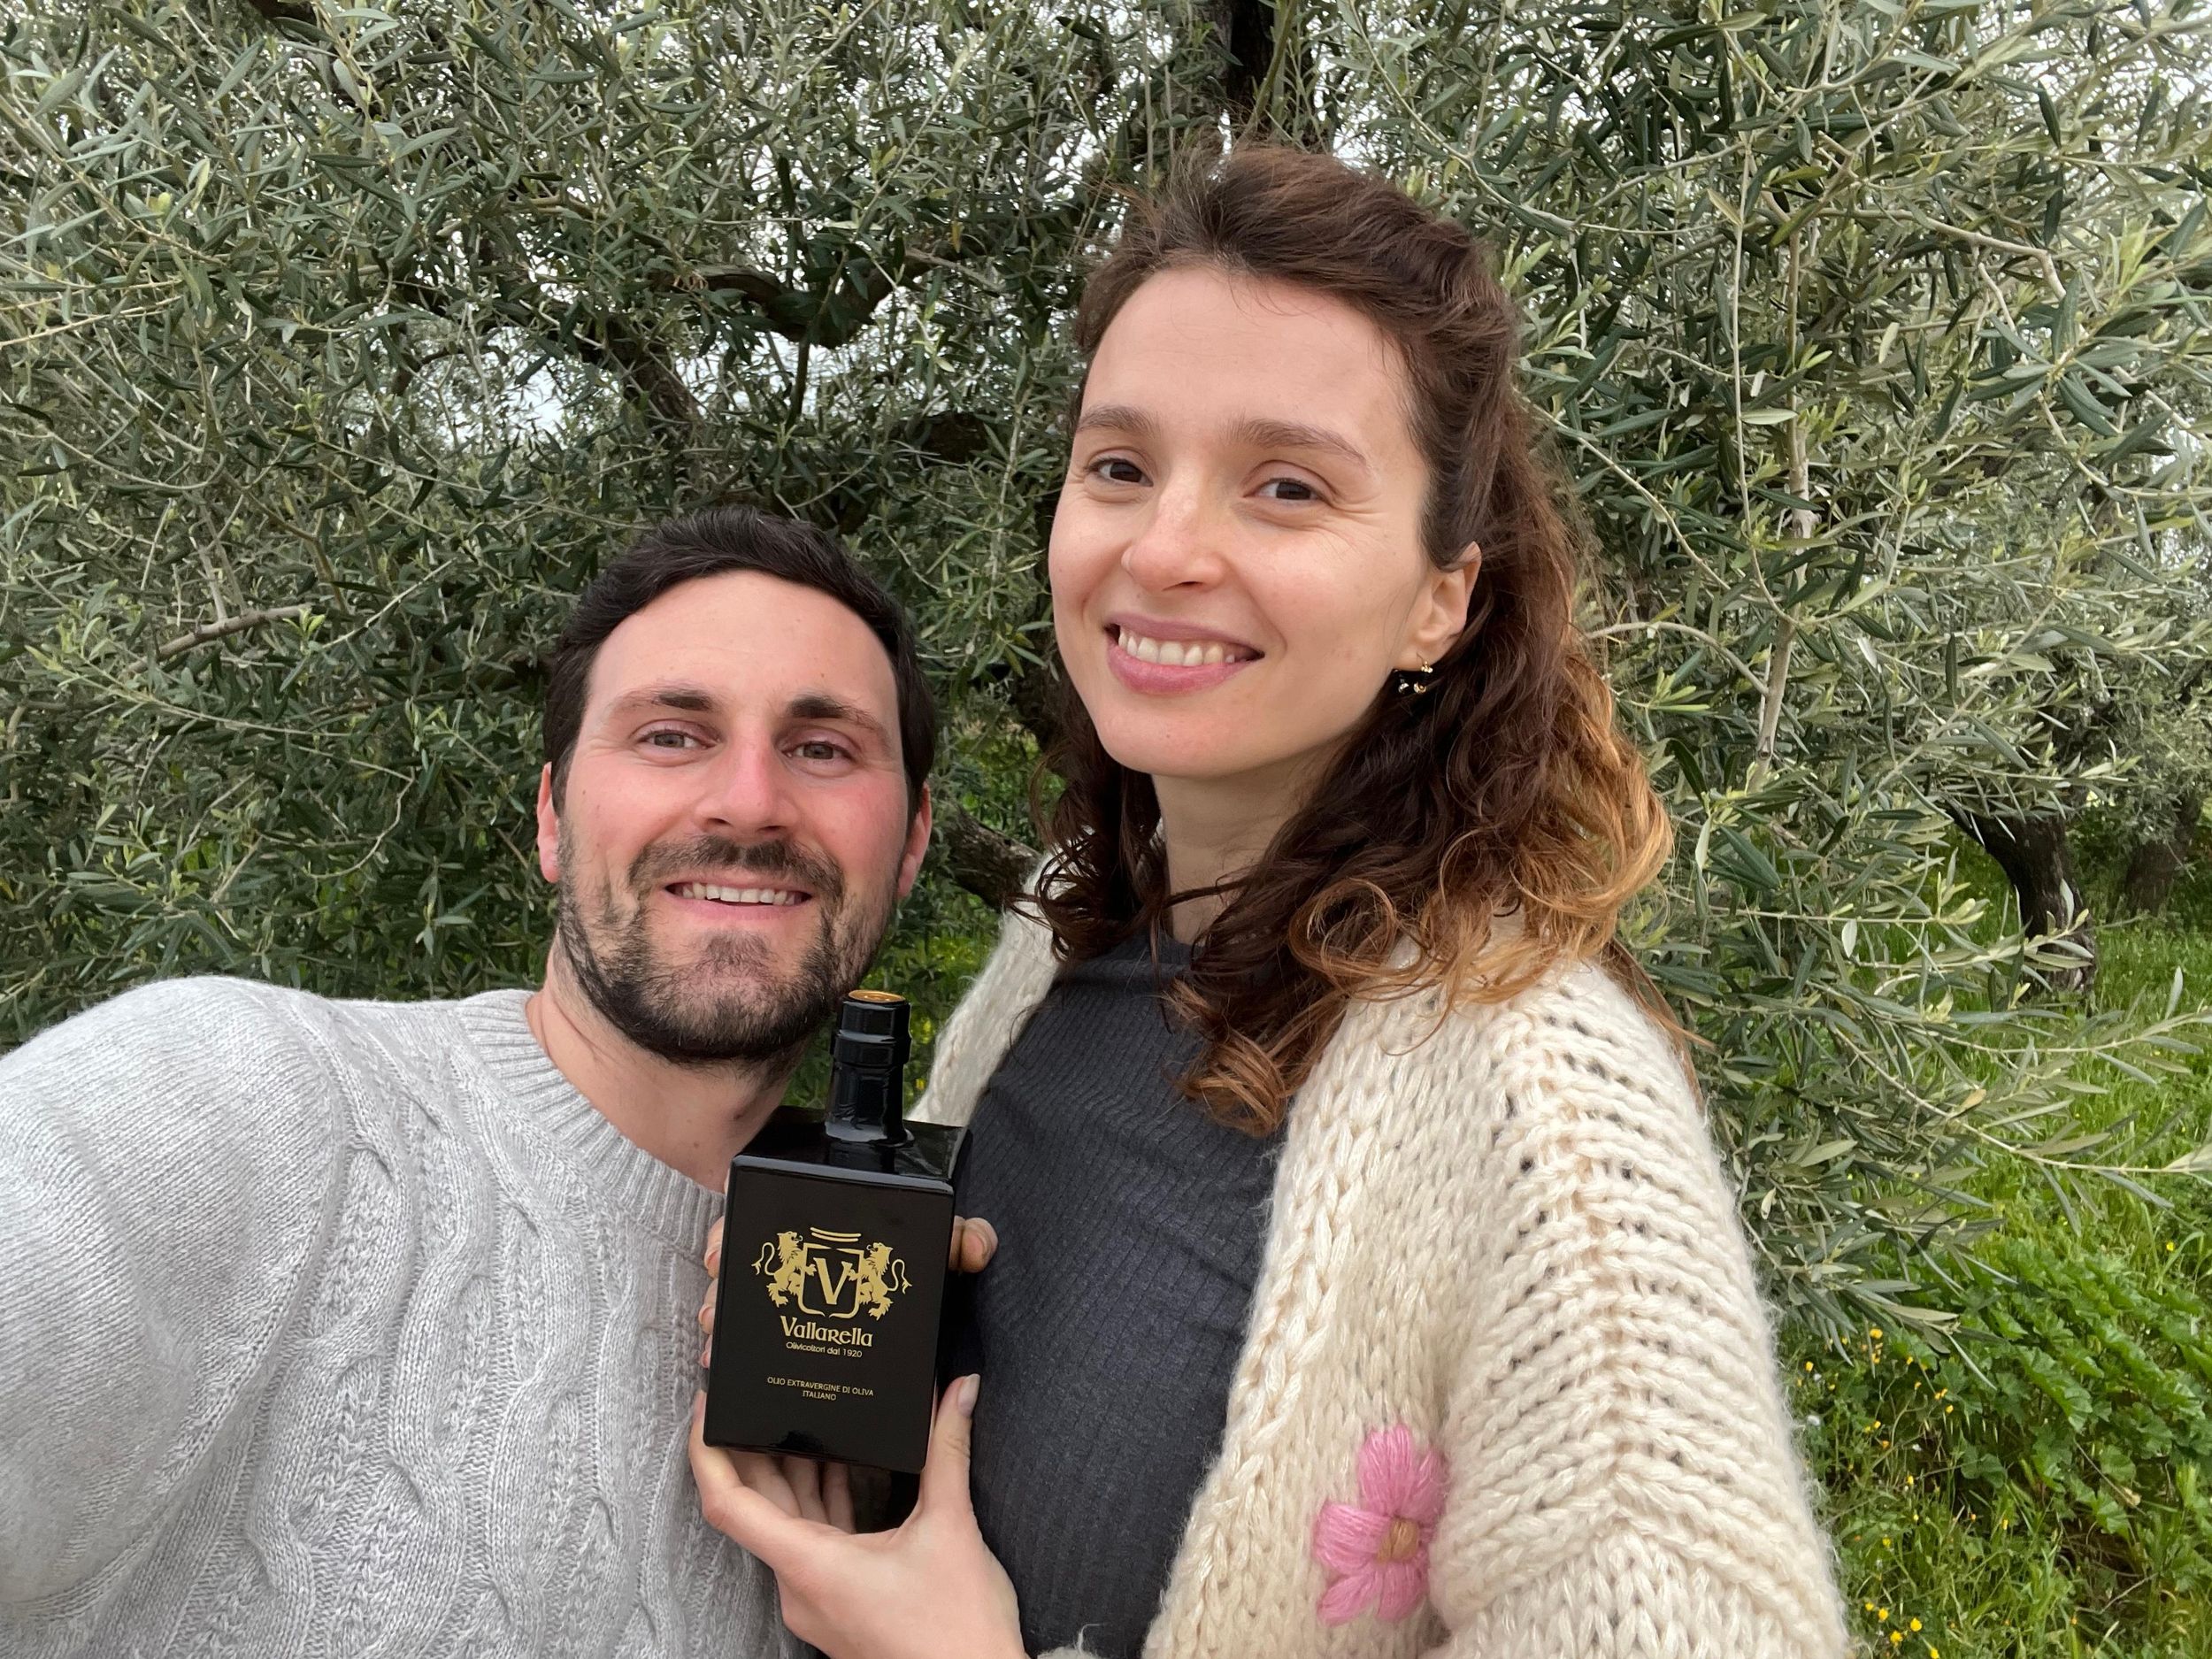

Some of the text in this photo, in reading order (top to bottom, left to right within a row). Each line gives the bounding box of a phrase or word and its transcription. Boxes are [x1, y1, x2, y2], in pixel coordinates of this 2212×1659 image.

[813, 1257, 852, 1305] V
[780, 1315, 873, 1347] Vallarella
[786, 1341, 863, 1358] Olivicoltori dal 1920
[766, 1376, 786, 1386] OLIO
[787, 1379, 841, 1393] EXTRAVERGINE
[851, 1386, 874, 1396] OLIVA
[802, 1390, 837, 1401] ITALIANO
